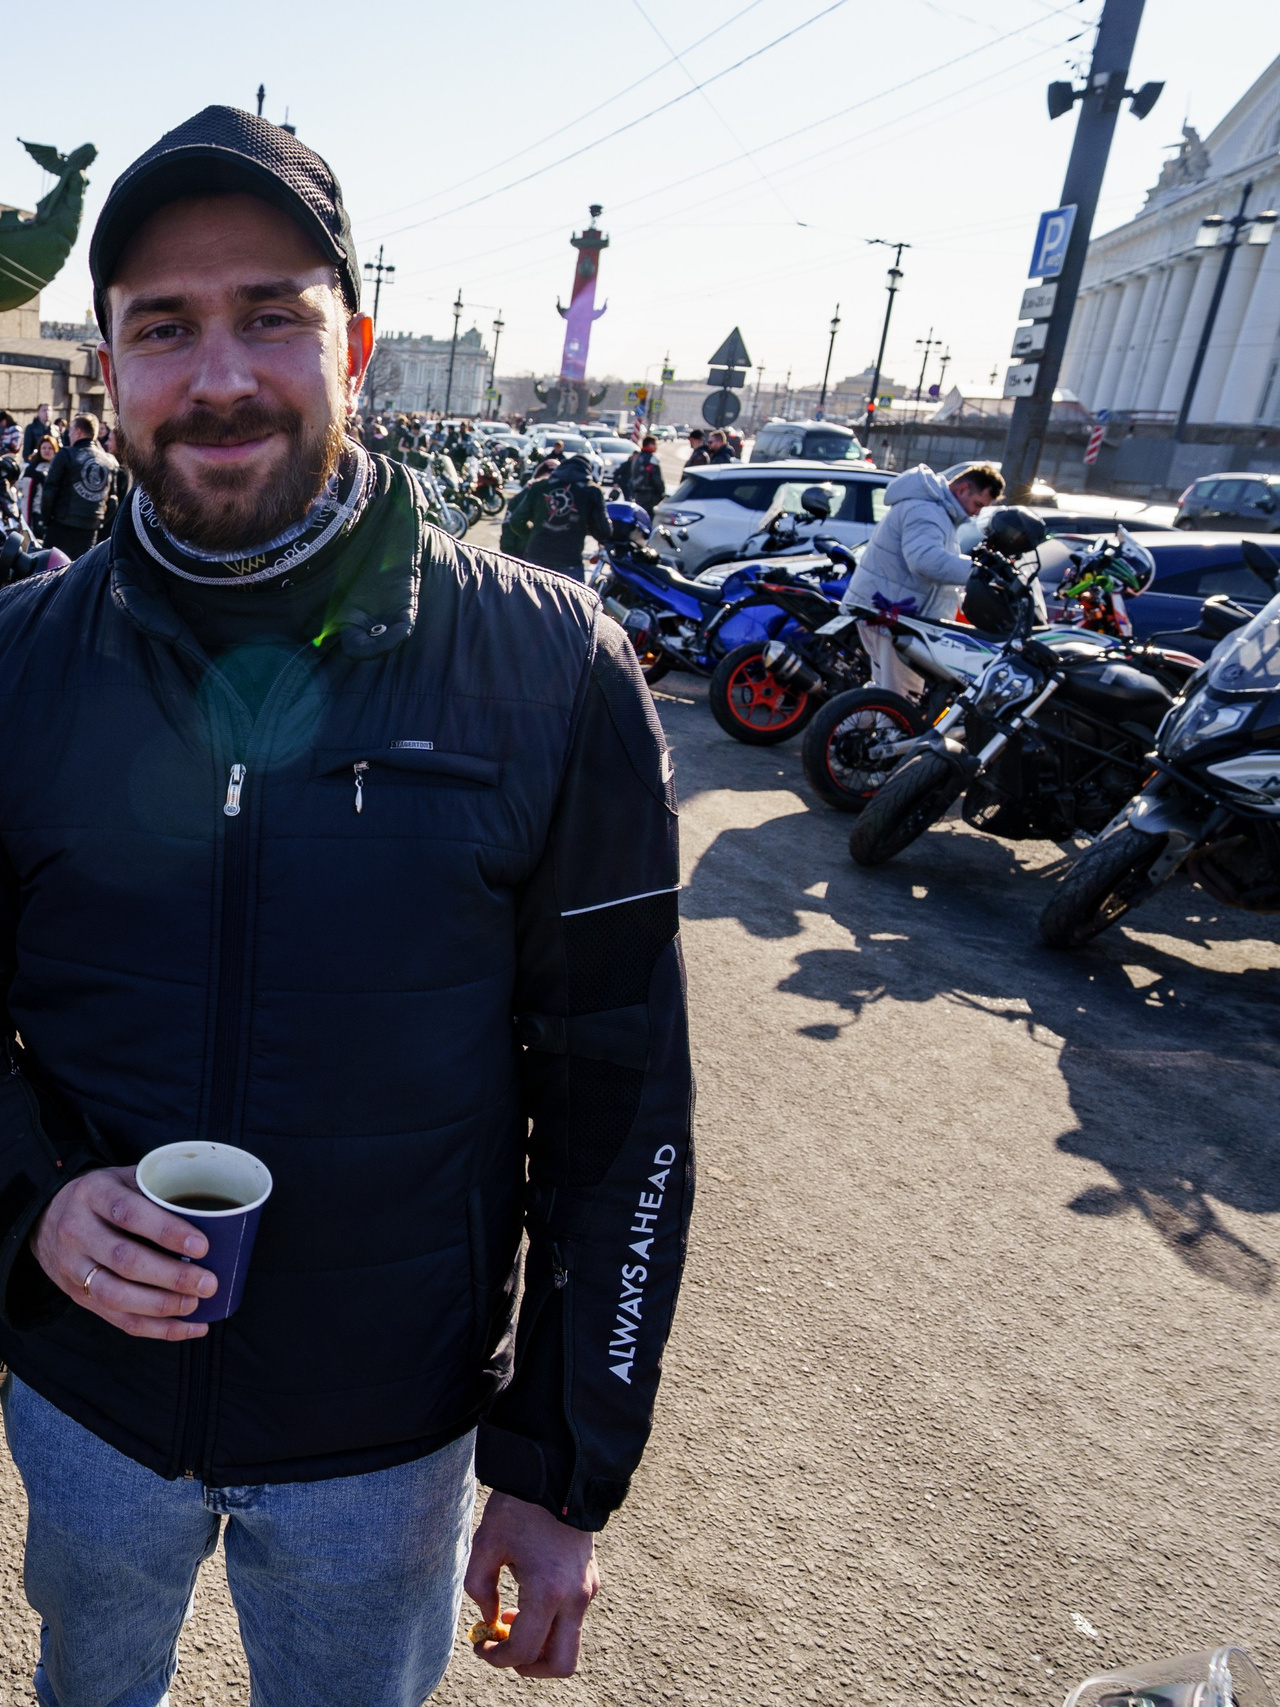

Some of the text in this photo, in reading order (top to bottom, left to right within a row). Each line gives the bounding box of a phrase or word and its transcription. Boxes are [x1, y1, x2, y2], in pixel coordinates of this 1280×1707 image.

[1037, 216, 1067, 270] P
[608, 1144, 676, 1385] ALWAYS AHEAD
